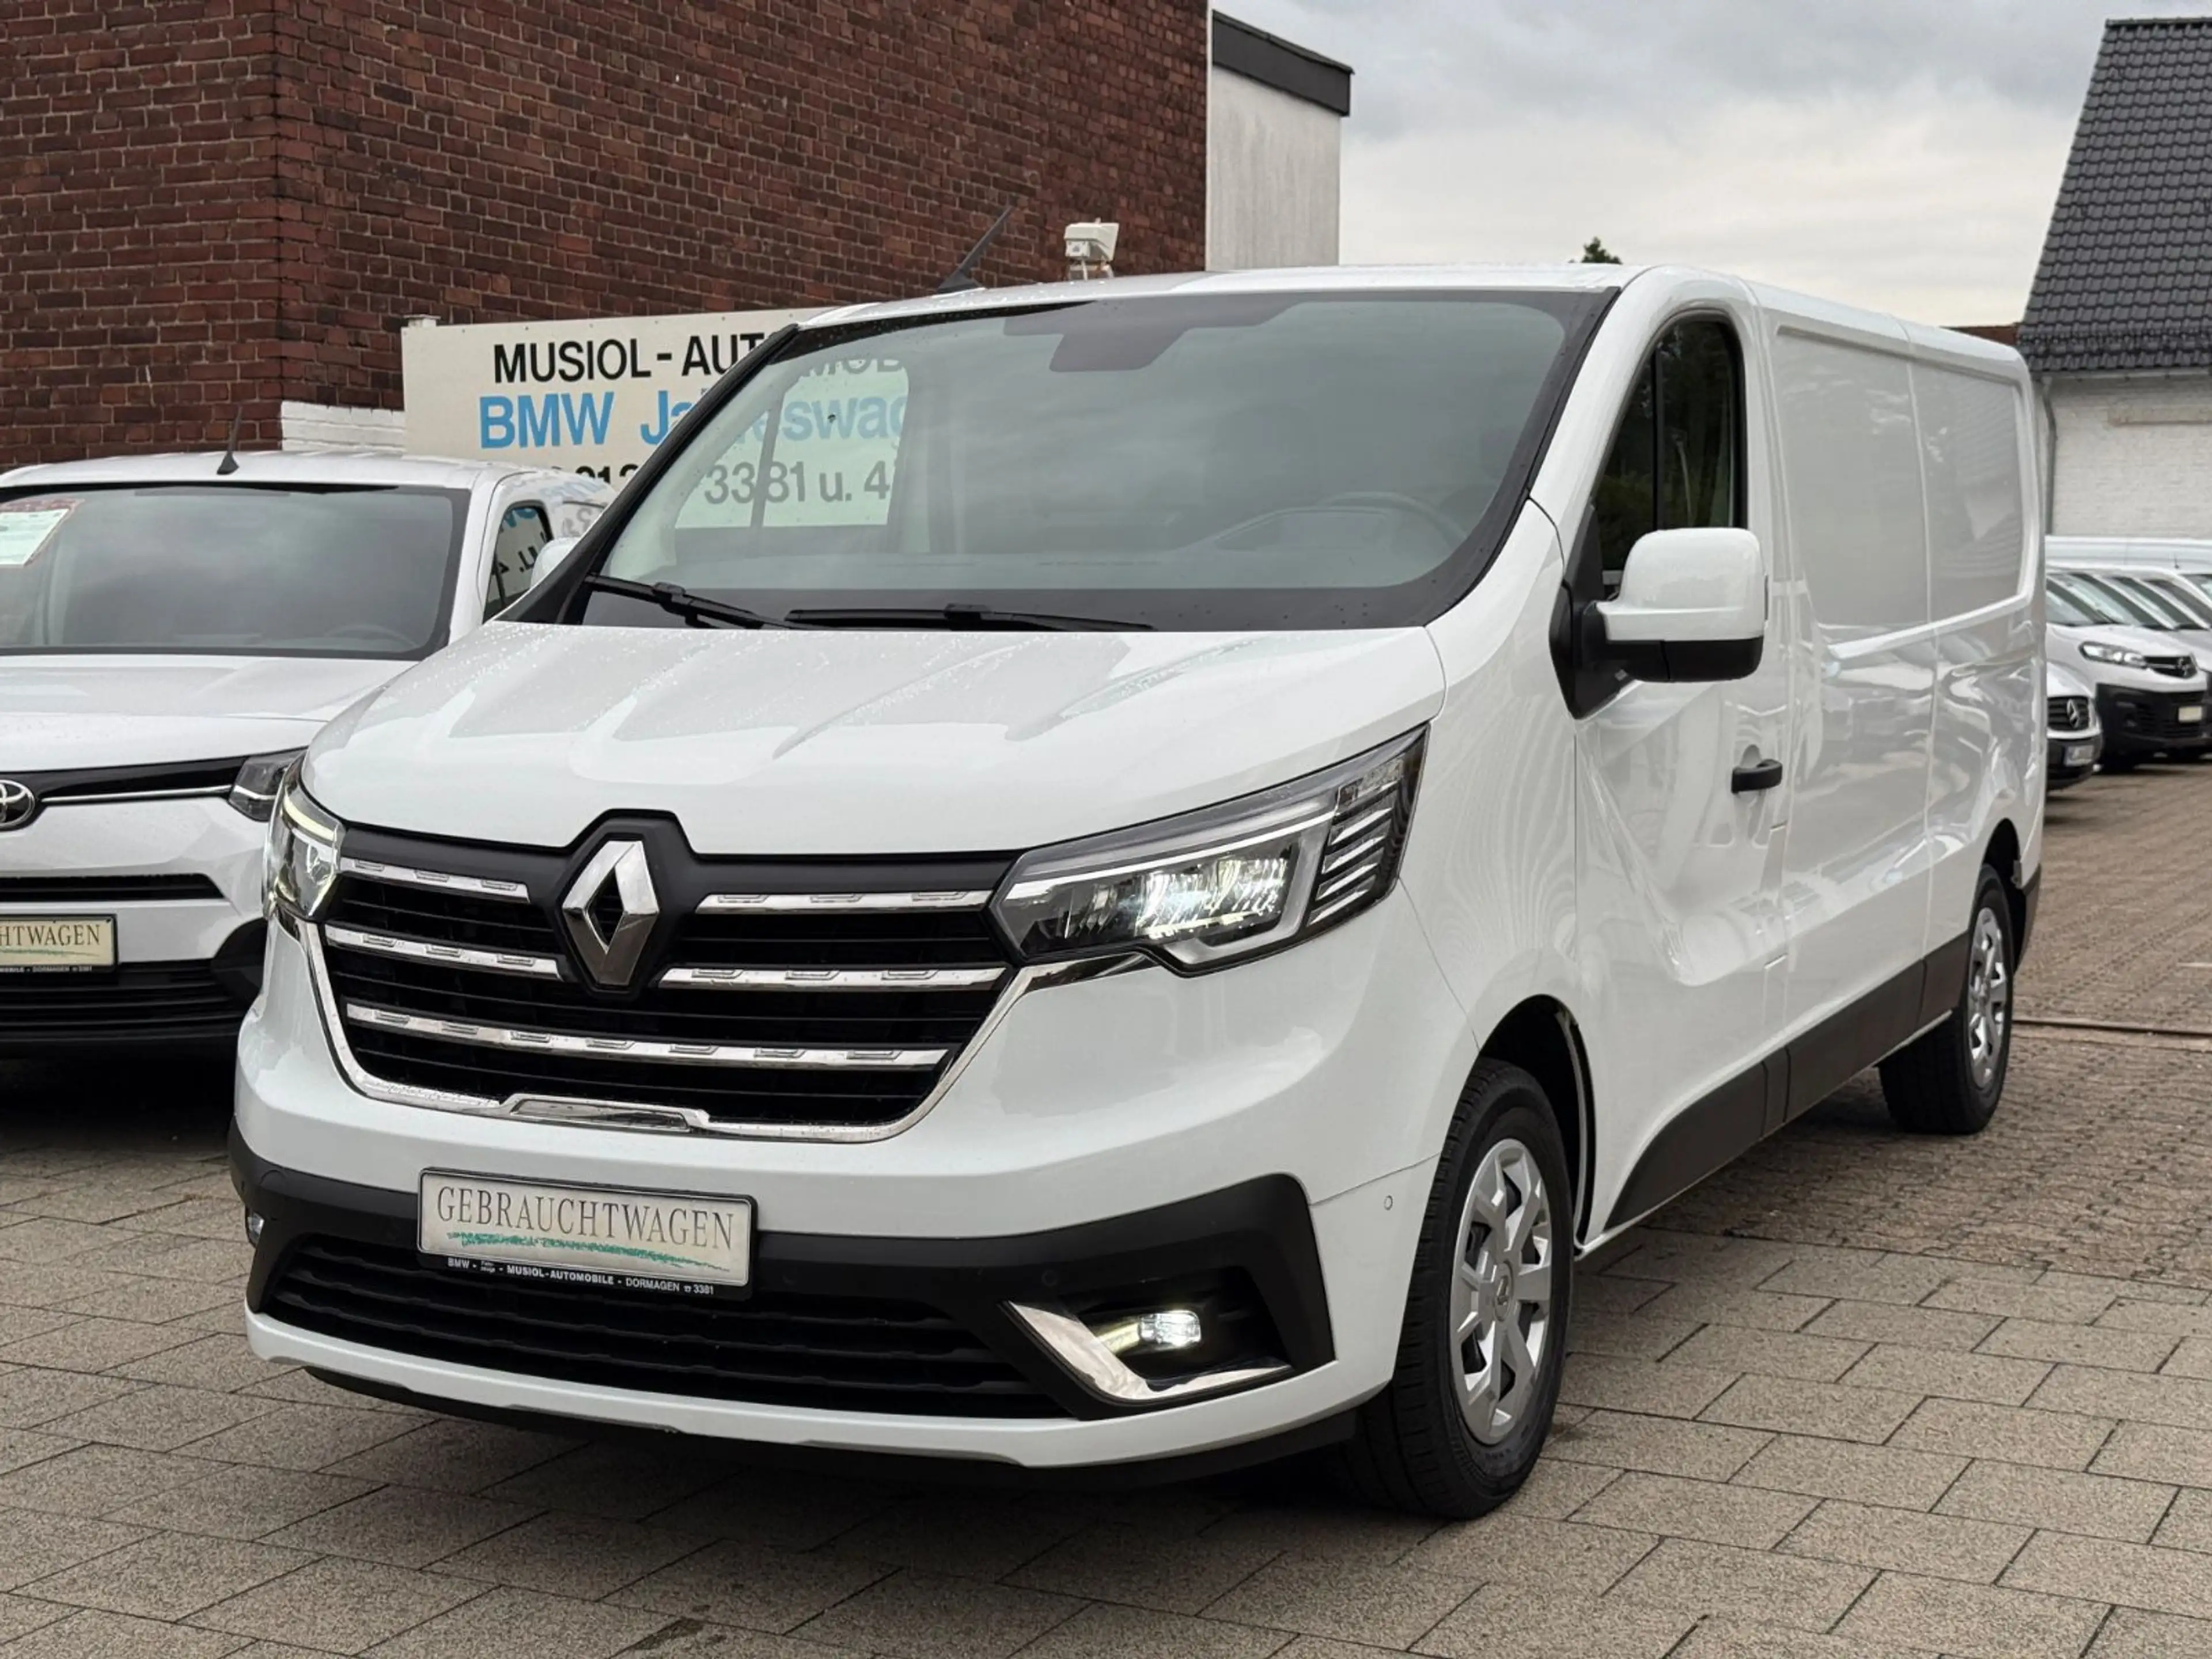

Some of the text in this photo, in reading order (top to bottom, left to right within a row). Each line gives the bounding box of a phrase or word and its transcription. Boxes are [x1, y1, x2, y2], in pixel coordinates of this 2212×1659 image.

[479, 391, 615, 449] BMW
[704, 461, 805, 505] 3381
[437, 1185, 734, 1251] GEBRAUCHTWAGEN
[448, 1257, 469, 1269] BMW
[507, 1264, 614, 1285] MUSIOL-AUTOMOBILE
[626, 1277, 680, 1292] DORMAGEN
